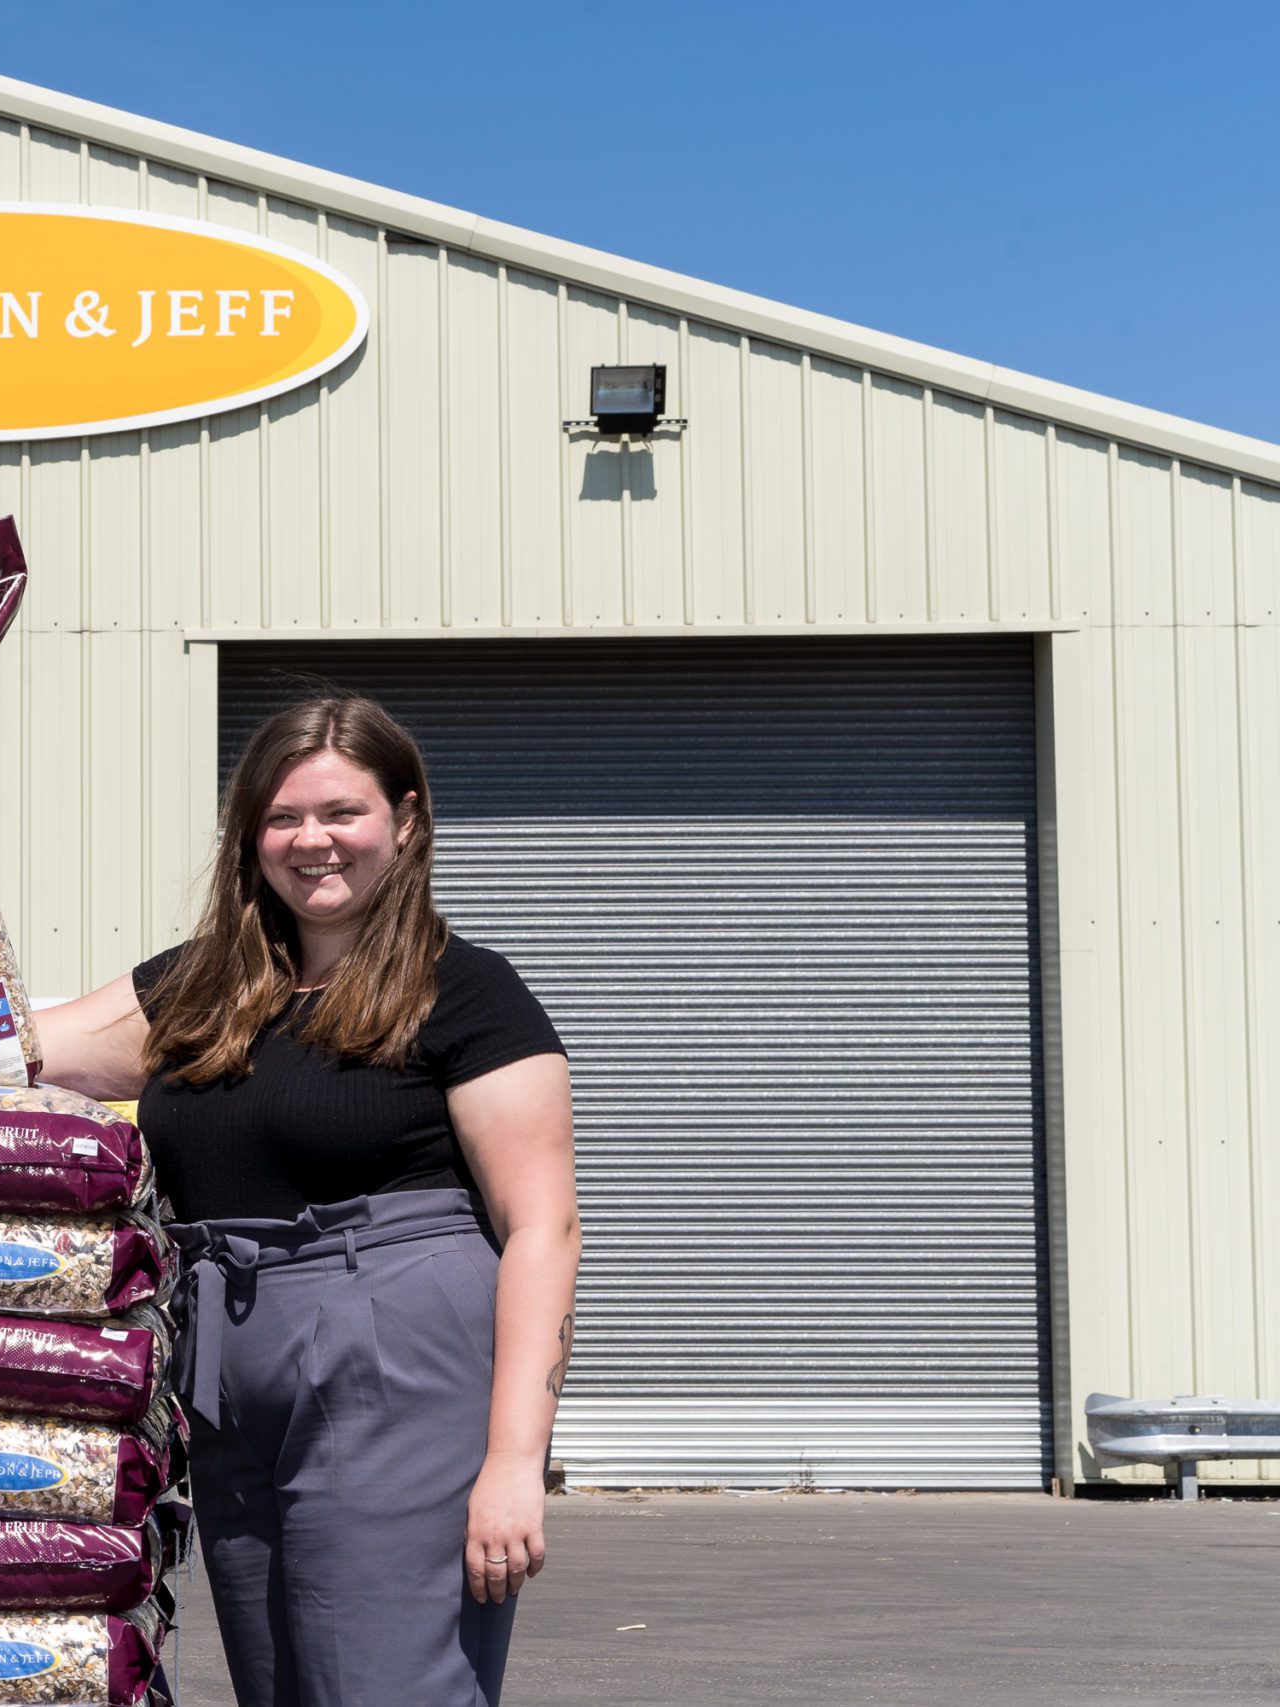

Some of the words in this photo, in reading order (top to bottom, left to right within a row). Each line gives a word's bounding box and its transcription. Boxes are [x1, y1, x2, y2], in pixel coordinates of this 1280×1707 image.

[65, 290, 116, 338] &
[131, 289, 295, 348] JEFF
[14, 1256, 25, 1266] &
[26, 1258, 58, 1268] JEFF
[14, 1328, 57, 1344] FRUIT
[18, 1466, 28, 1478] &
[5, 1521, 48, 1534] FRUIT
[10, 1654, 19, 1663] &
